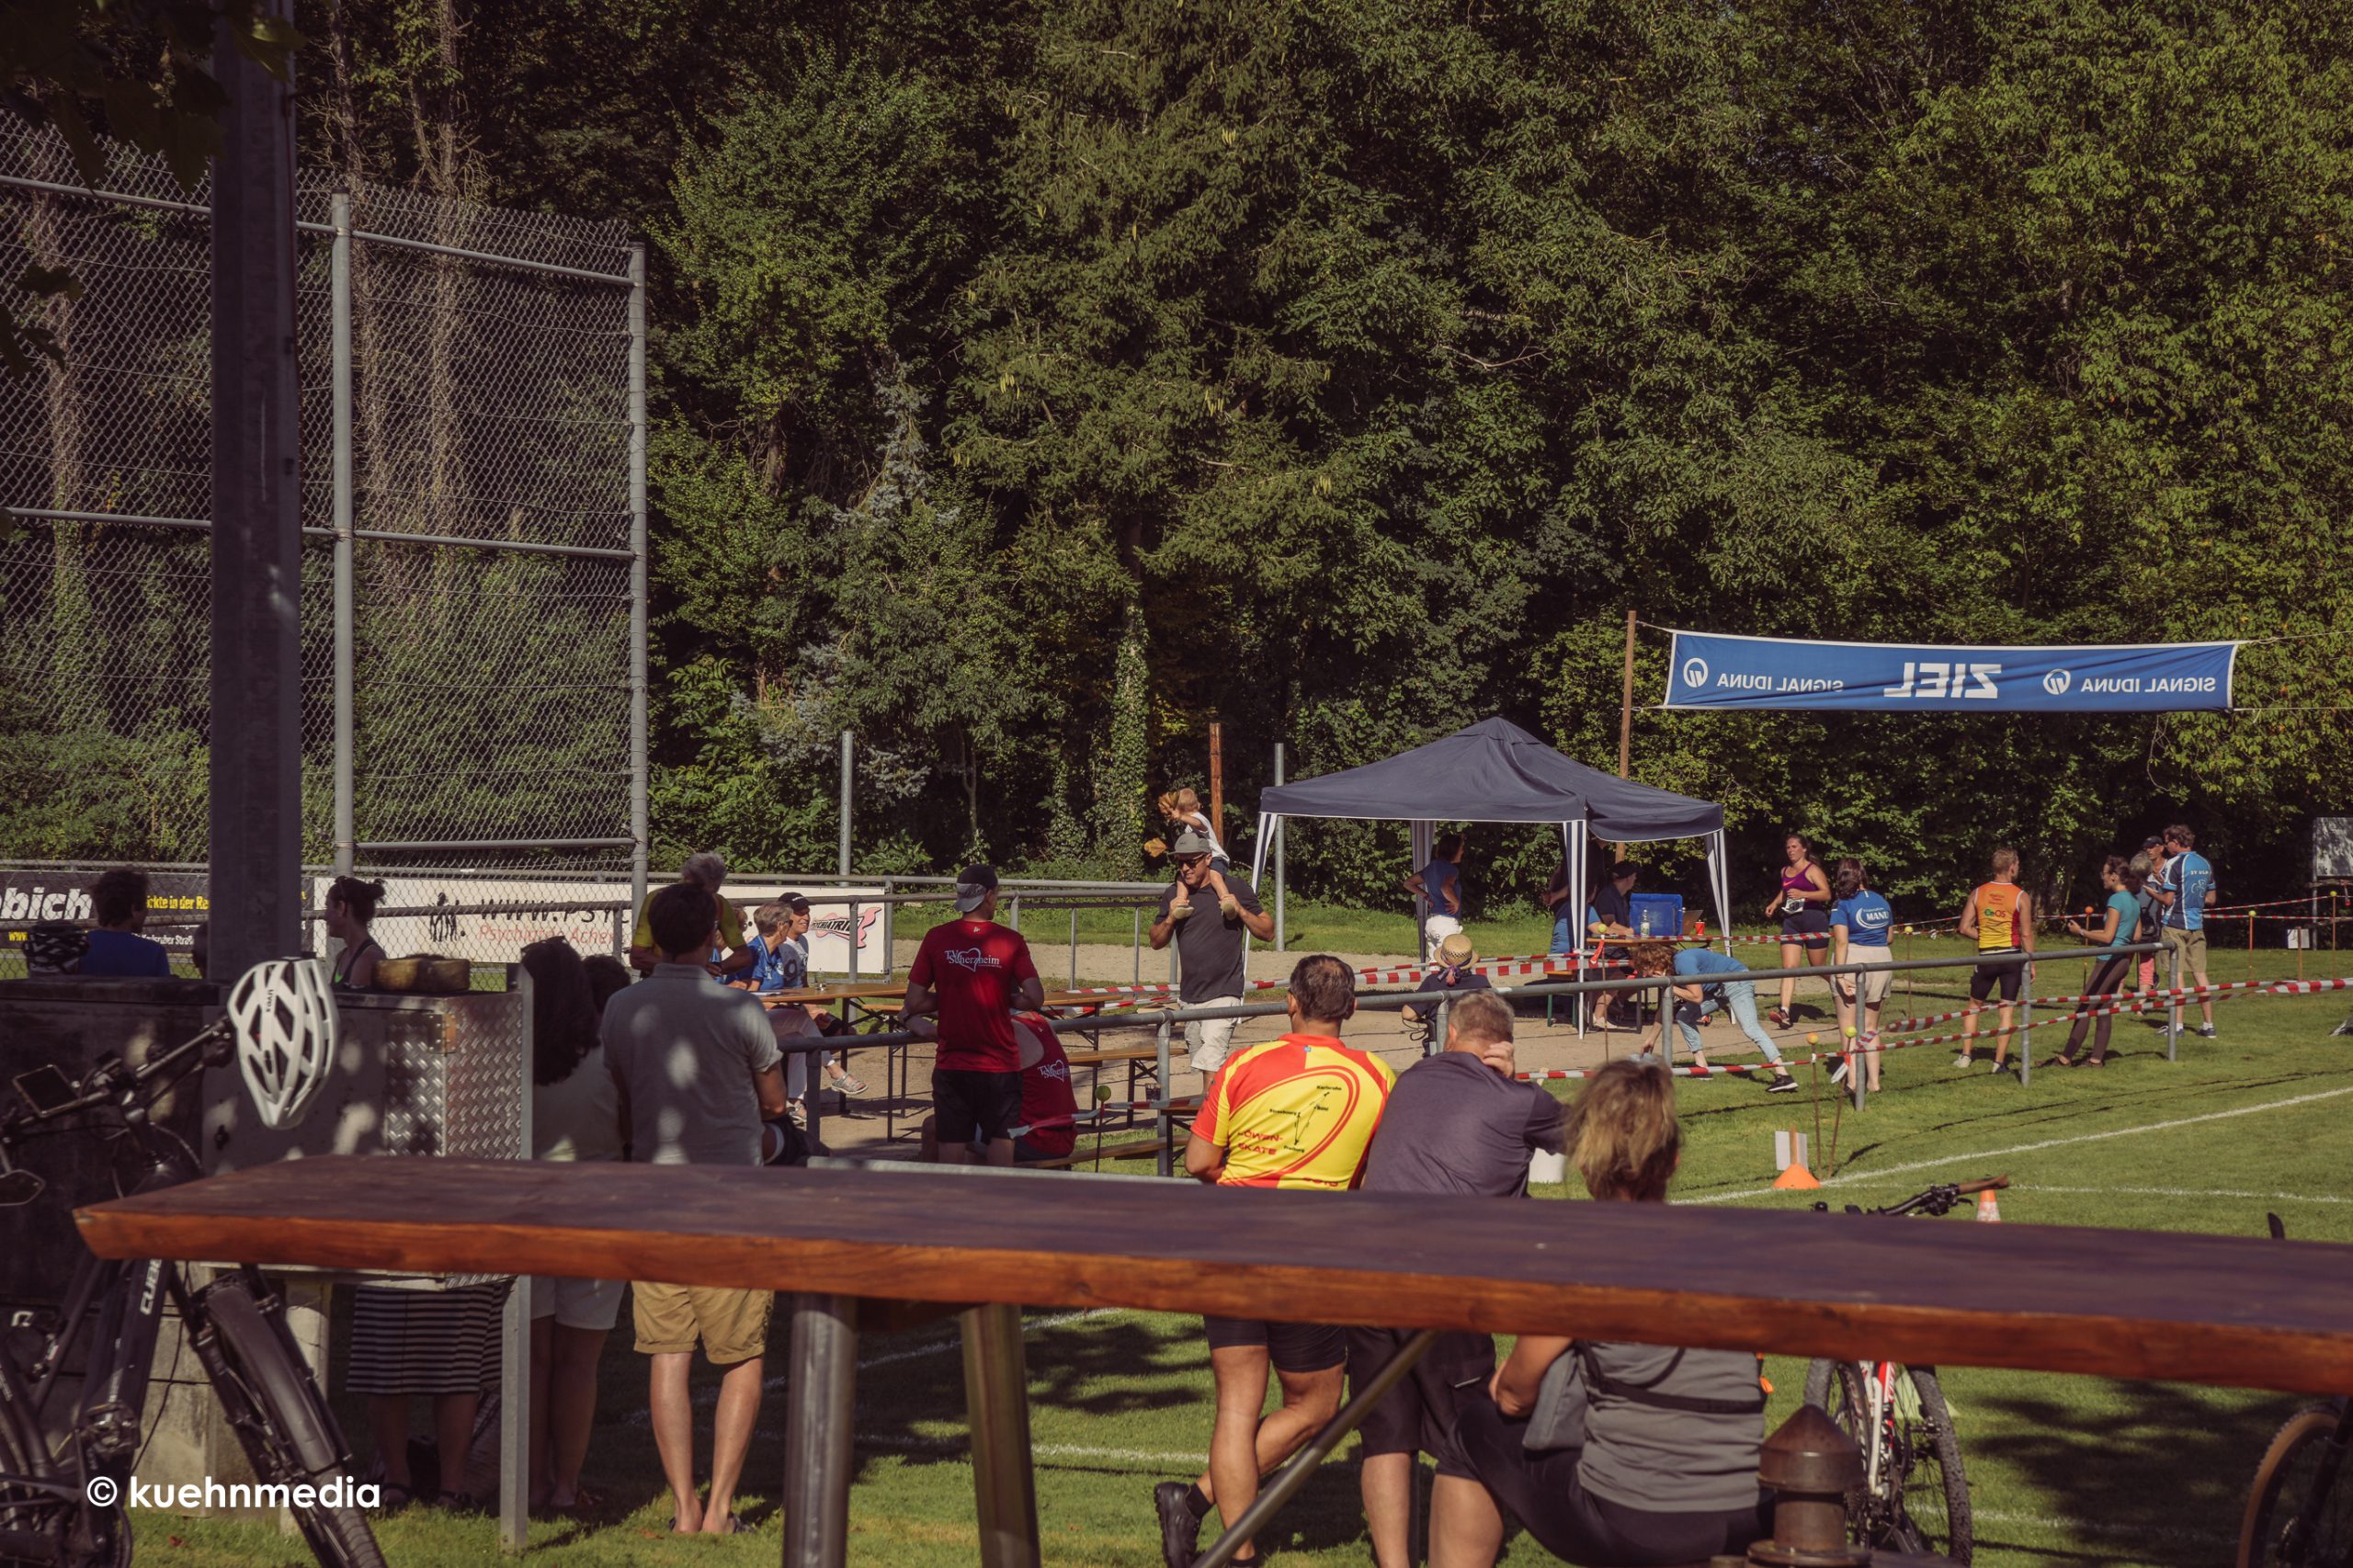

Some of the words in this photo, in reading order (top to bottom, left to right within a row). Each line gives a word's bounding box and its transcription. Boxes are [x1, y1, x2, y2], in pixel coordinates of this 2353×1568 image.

[0, 886, 93, 921] bich
[169, 895, 178, 909] in
[179, 895, 195, 910] der
[196, 895, 210, 911] Re
[949, 954, 1000, 965] Scherzheim
